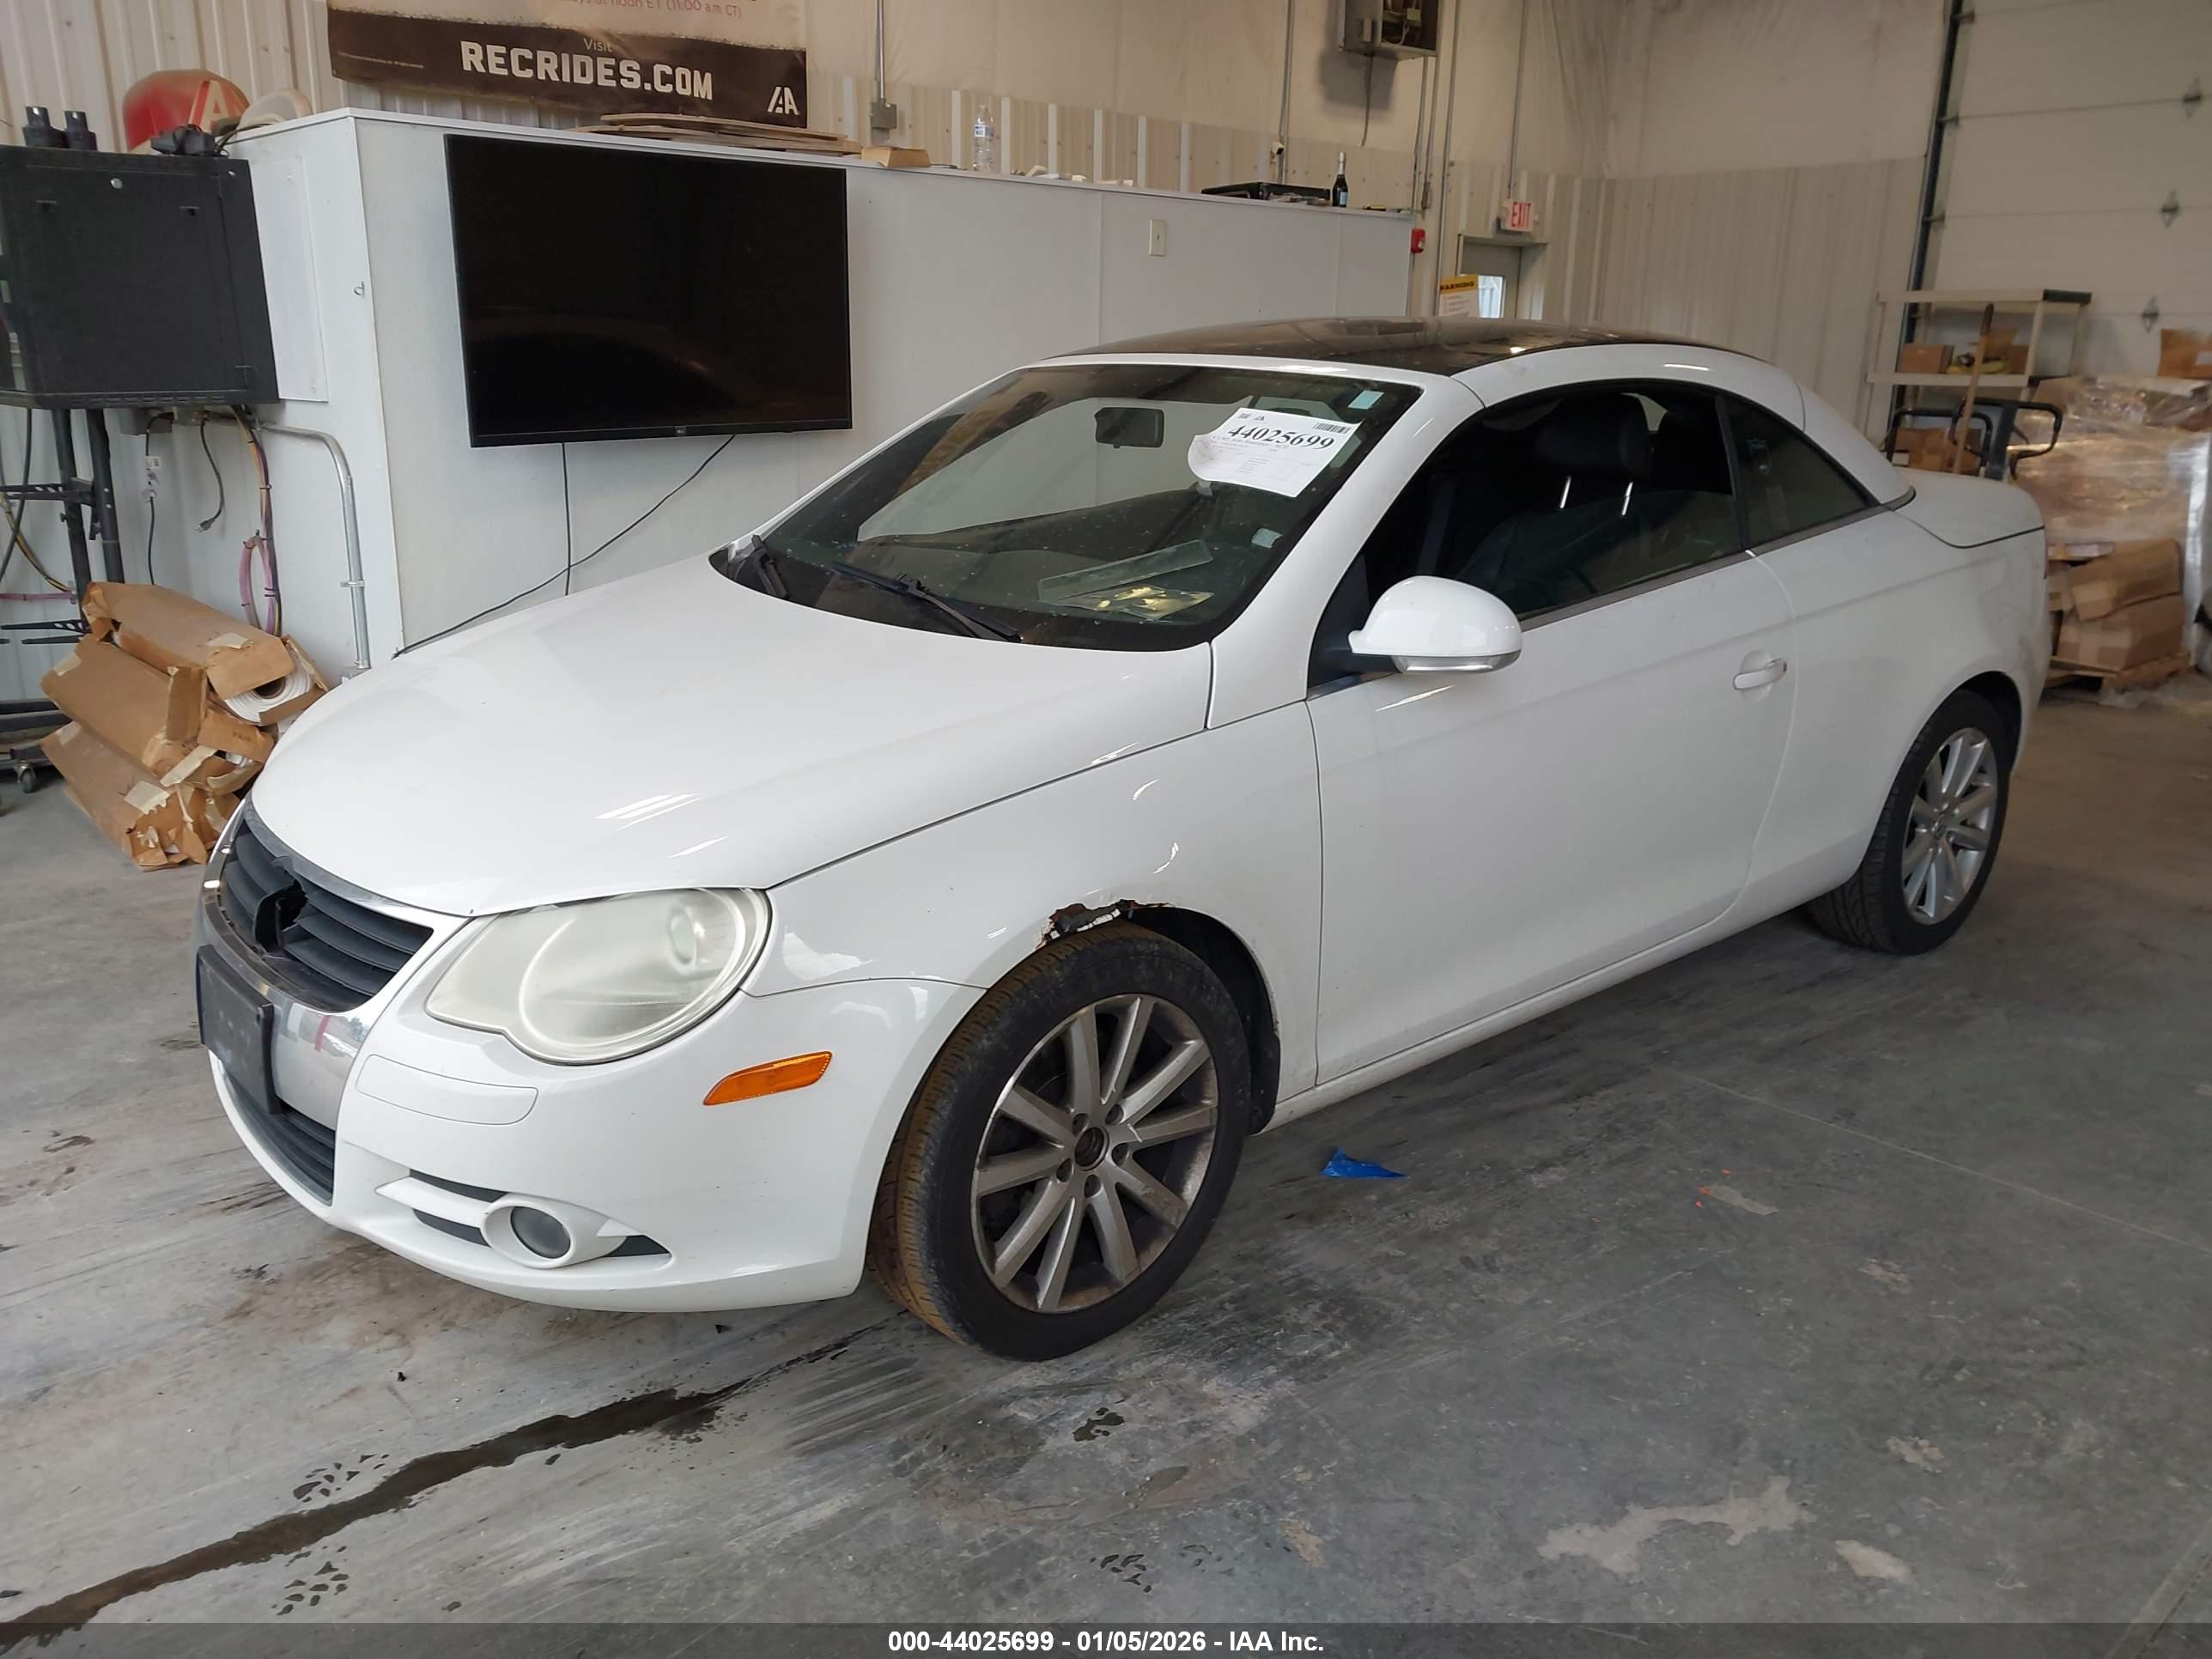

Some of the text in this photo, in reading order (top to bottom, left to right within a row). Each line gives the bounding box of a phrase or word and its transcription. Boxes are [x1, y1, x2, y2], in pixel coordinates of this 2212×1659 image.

[583, 38, 612, 53] Visit
[460, 40, 713, 100] RECRIDES.COM
[1511, 201, 1531, 228] EXIT
[1228, 425, 1334, 450] 44025699
